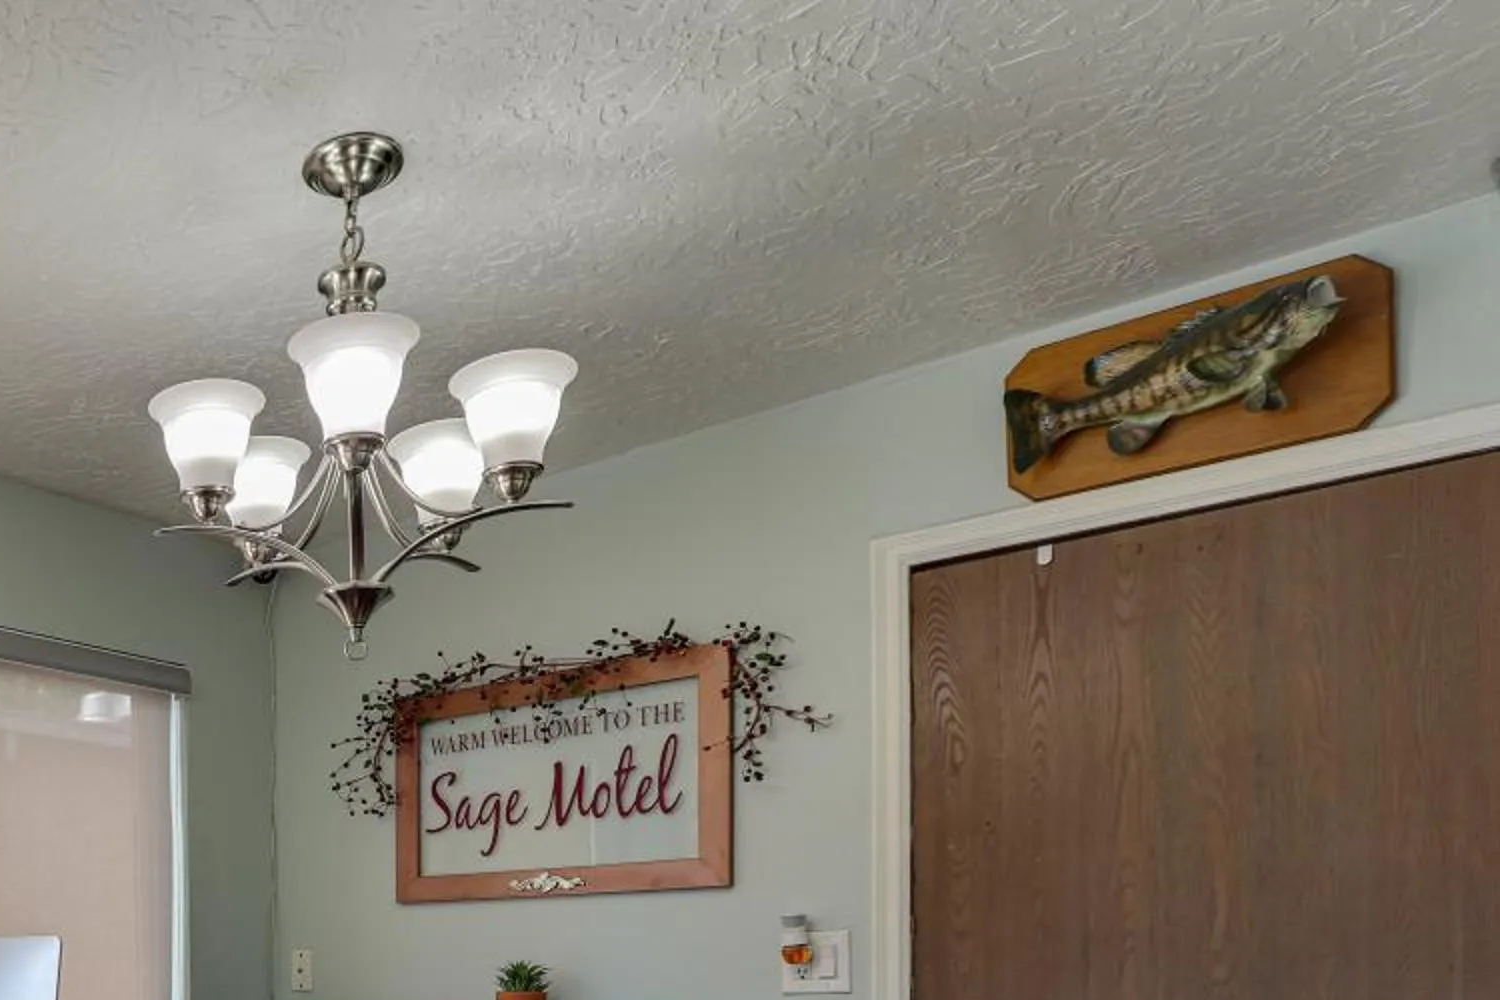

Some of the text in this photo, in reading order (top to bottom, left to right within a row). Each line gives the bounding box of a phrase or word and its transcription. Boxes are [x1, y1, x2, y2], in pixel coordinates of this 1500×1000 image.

[431, 701, 685, 757] WARM WELCOME TO THE
[426, 733, 683, 857] Sage Motel
